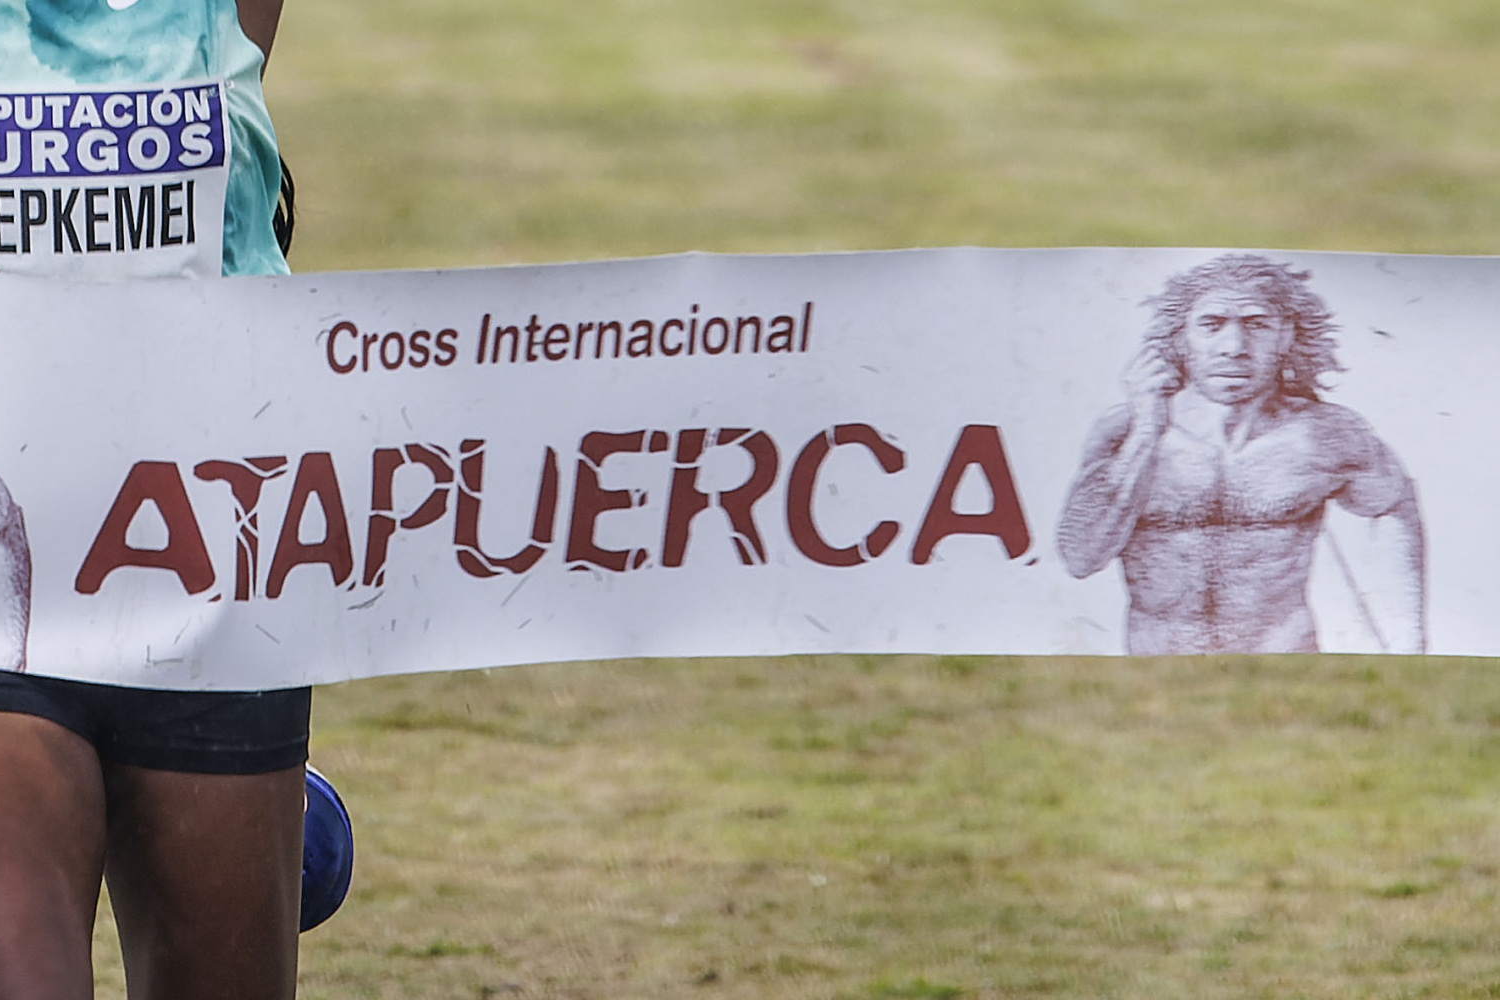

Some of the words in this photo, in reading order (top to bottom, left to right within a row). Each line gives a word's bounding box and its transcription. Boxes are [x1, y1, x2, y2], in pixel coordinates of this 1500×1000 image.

[326, 321, 458, 375] Cross
[476, 302, 813, 366] Internacional
[74, 422, 1040, 603] ATAPUERCA
